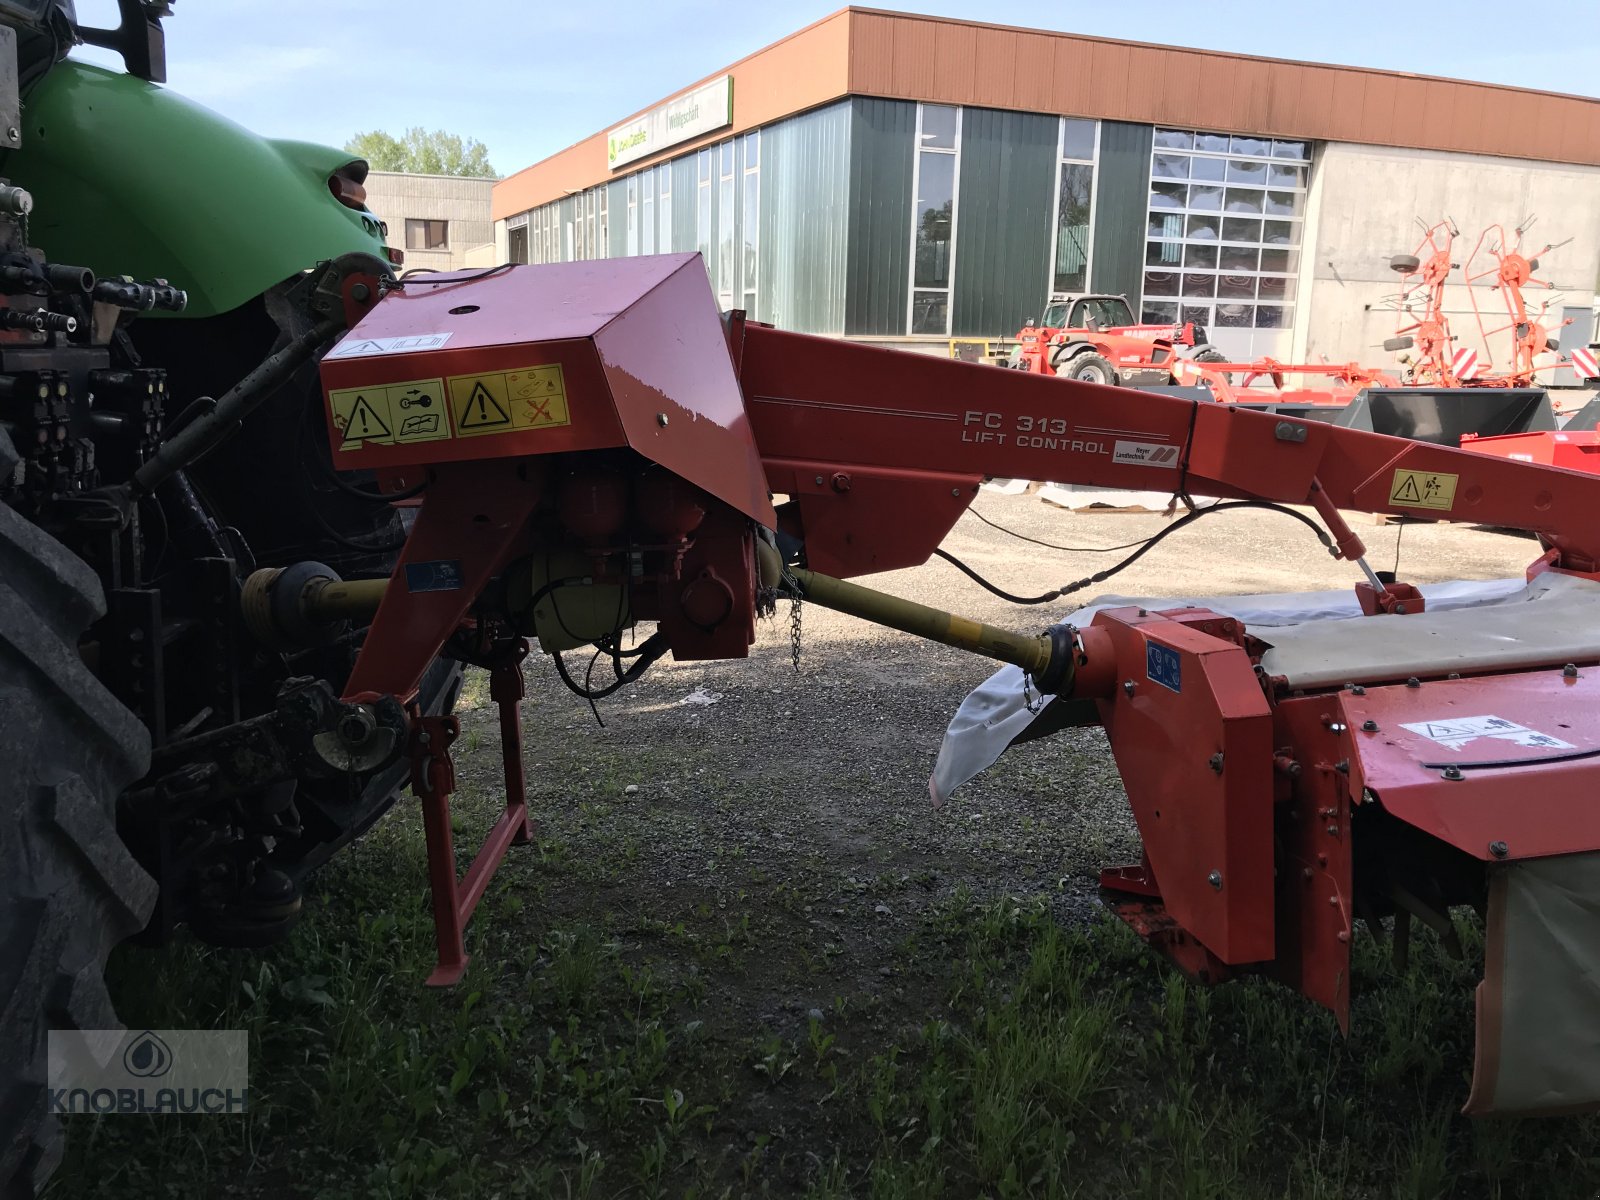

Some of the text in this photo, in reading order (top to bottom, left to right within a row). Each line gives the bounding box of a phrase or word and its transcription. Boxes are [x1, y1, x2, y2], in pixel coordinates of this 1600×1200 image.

[963, 410, 1068, 435] FC 313
[961, 430, 1110, 455] LIFT CONTROL
[1115, 451, 1145, 460] Landtechnik
